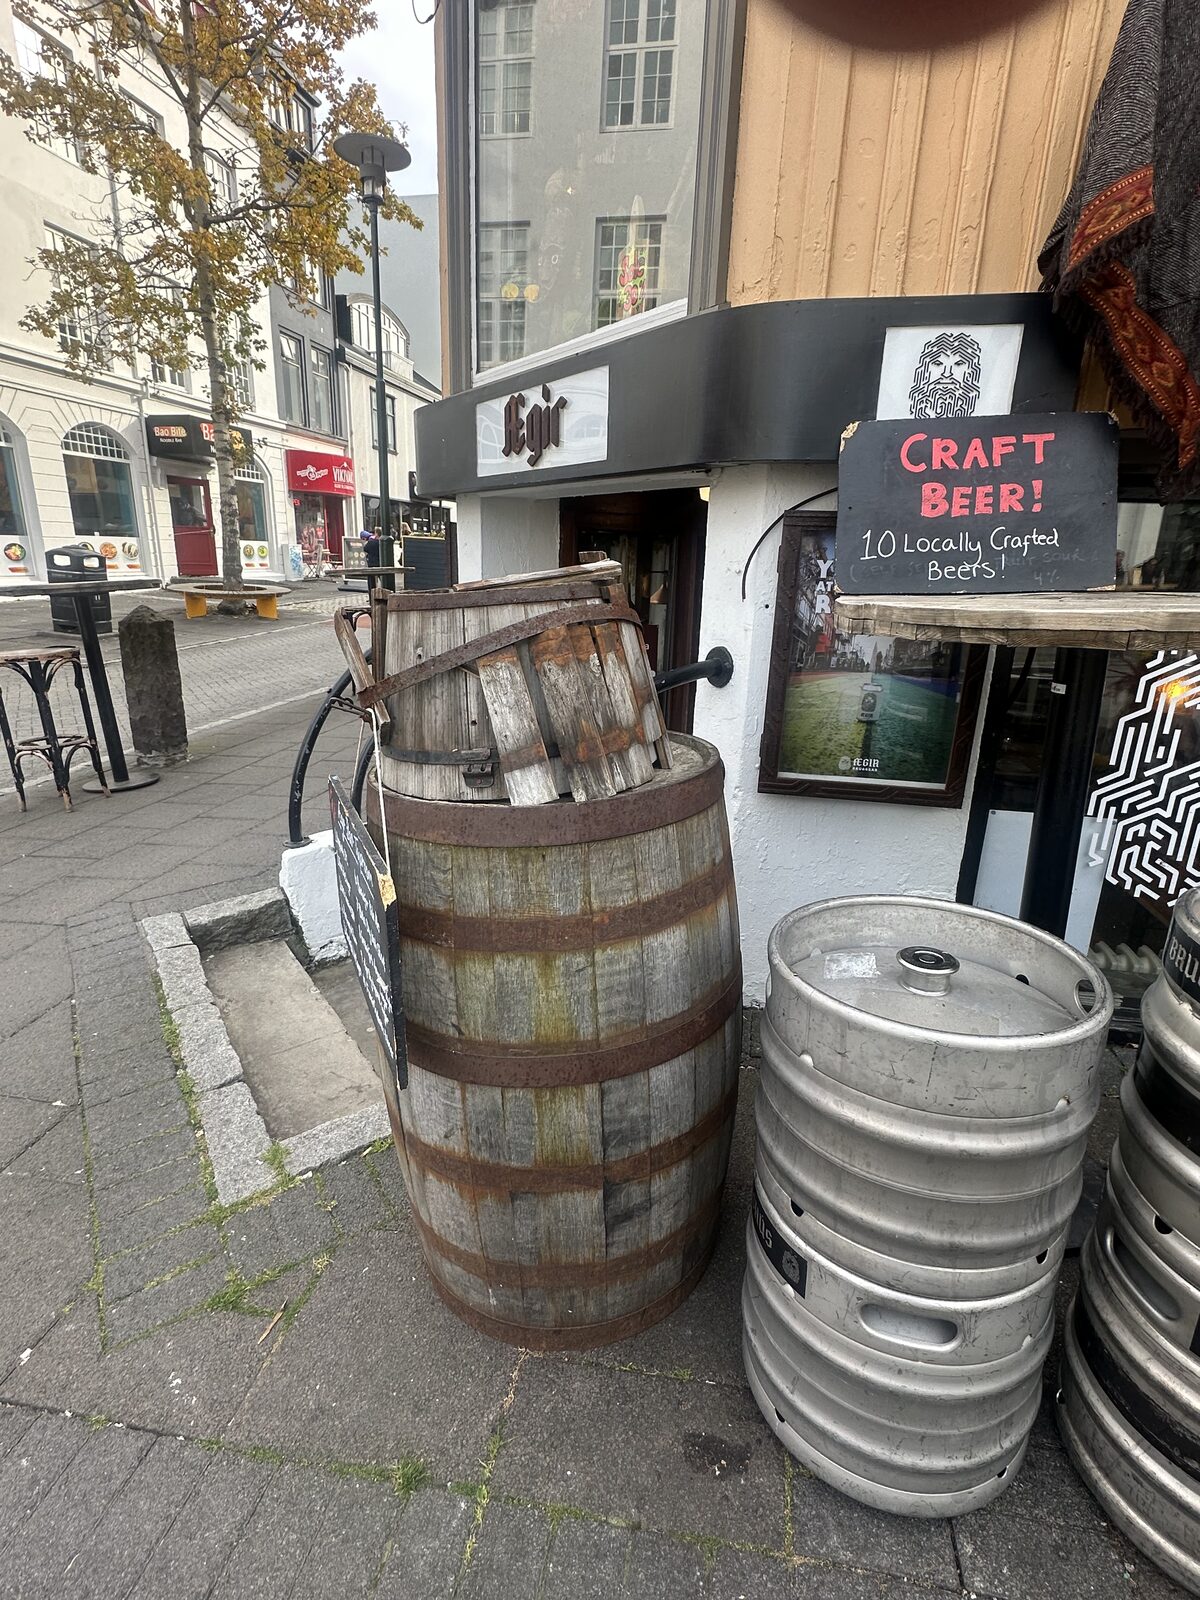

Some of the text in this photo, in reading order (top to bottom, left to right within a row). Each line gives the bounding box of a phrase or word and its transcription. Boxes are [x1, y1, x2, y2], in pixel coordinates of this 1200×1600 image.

[154, 426, 187, 438] Bao Bite
[201, 423, 215, 441] Ba
[900, 433, 1055, 473] CRAFT
[920, 479, 1043, 518] BEER!
[860, 527, 1060, 567] 10 Locally Crafted
[928, 554, 1005, 581] Beers!
